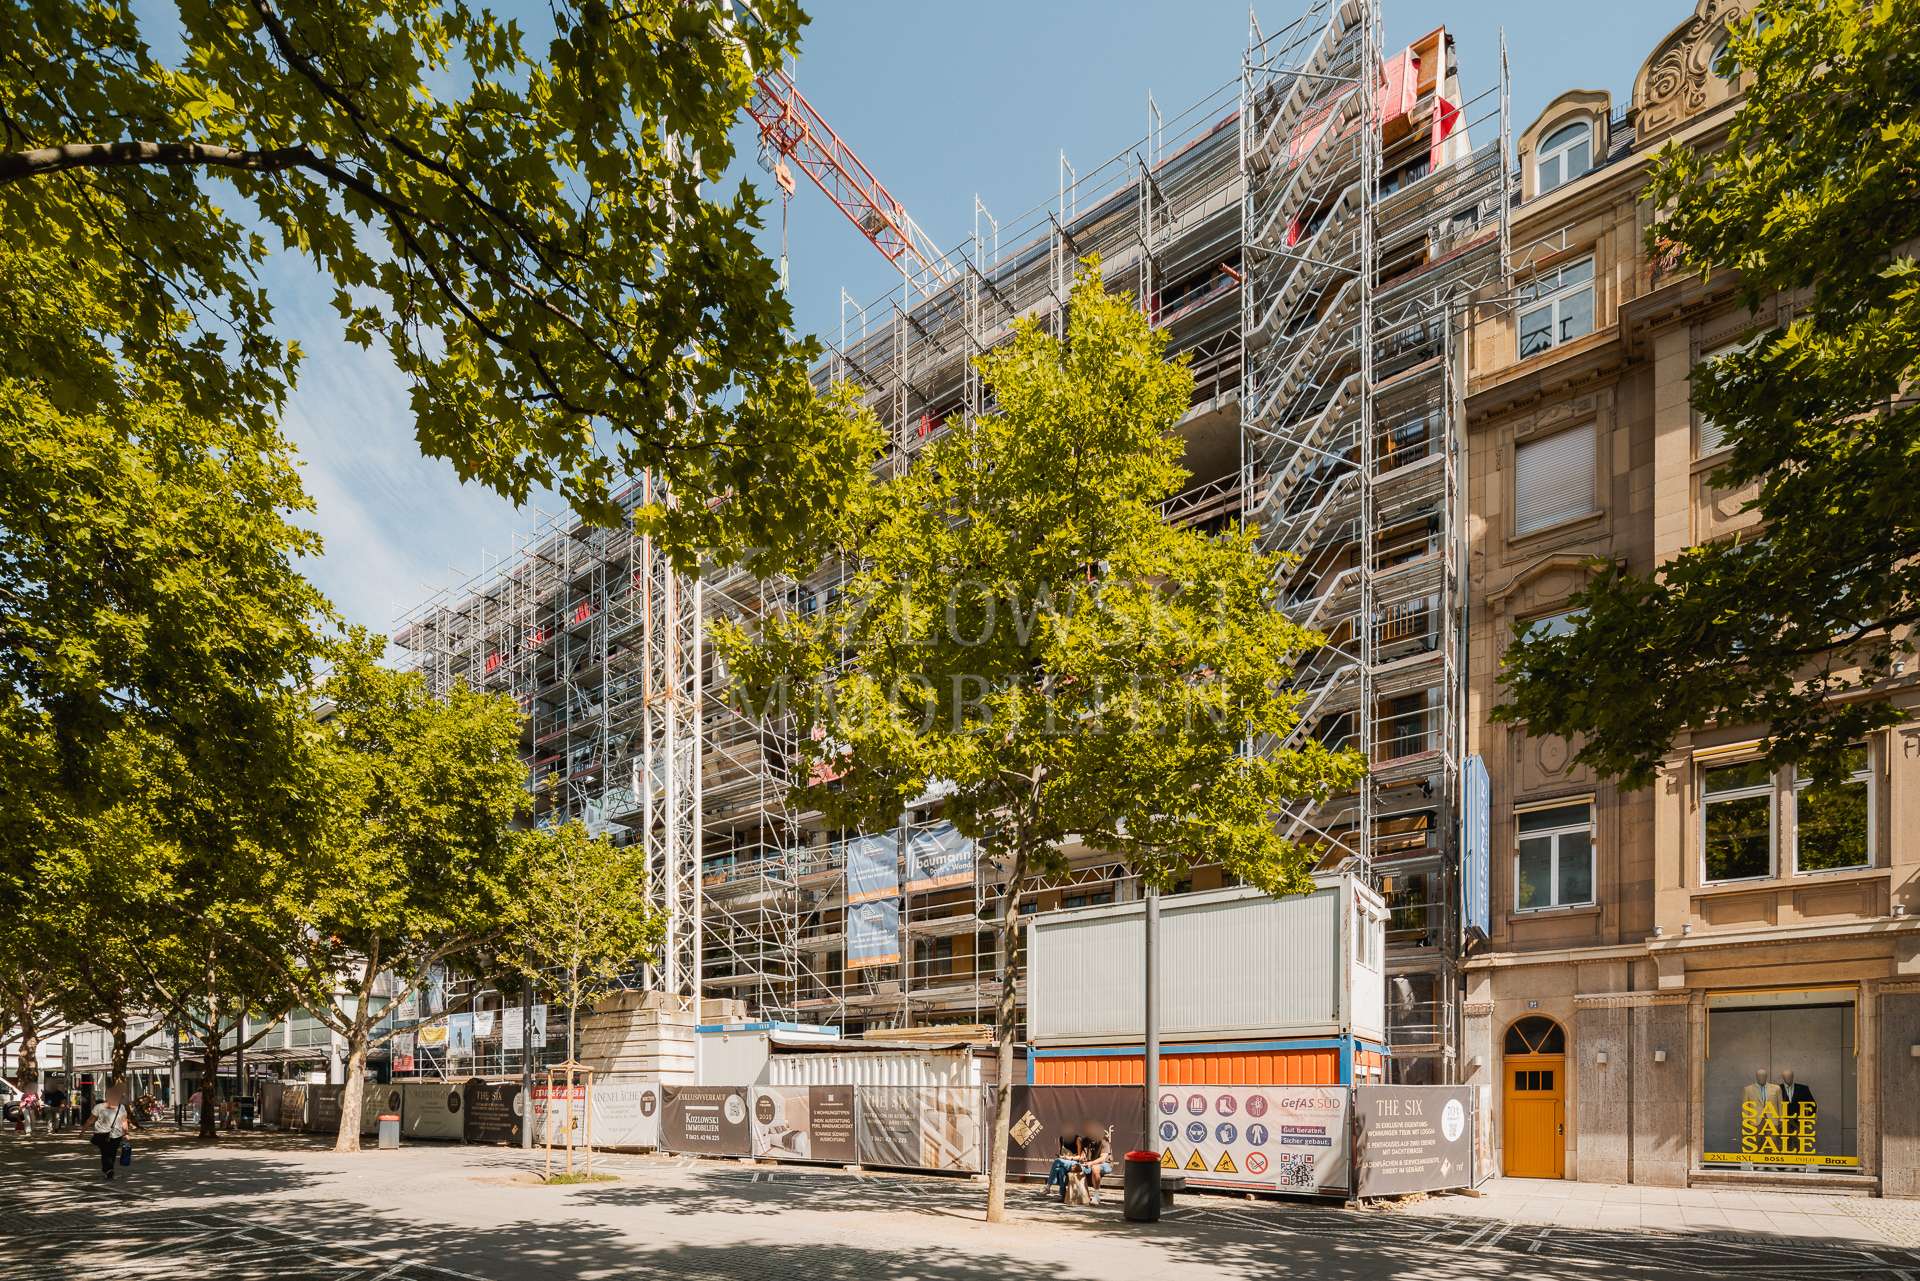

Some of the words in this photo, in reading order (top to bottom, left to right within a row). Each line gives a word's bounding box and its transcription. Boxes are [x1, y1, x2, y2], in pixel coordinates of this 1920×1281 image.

[915, 850, 971, 869] baumann
[1281, 1098, 1314, 1110] GefAS
[1376, 1099, 1400, 1116] THE
[1405, 1099, 1423, 1116] SIX
[1742, 1100, 1817, 1119] SALE
[685, 1112, 719, 1124] KOZLOWSKI
[685, 1123, 720, 1132] IMMOBILIEN
[1742, 1118, 1816, 1137] SALE
[1021, 1124, 1044, 1150] HOLDING
[1742, 1136, 1816, 1153] SALE
[1710, 1153, 1728, 1161] 2XL
[1825, 1157, 1847, 1165] Brax
